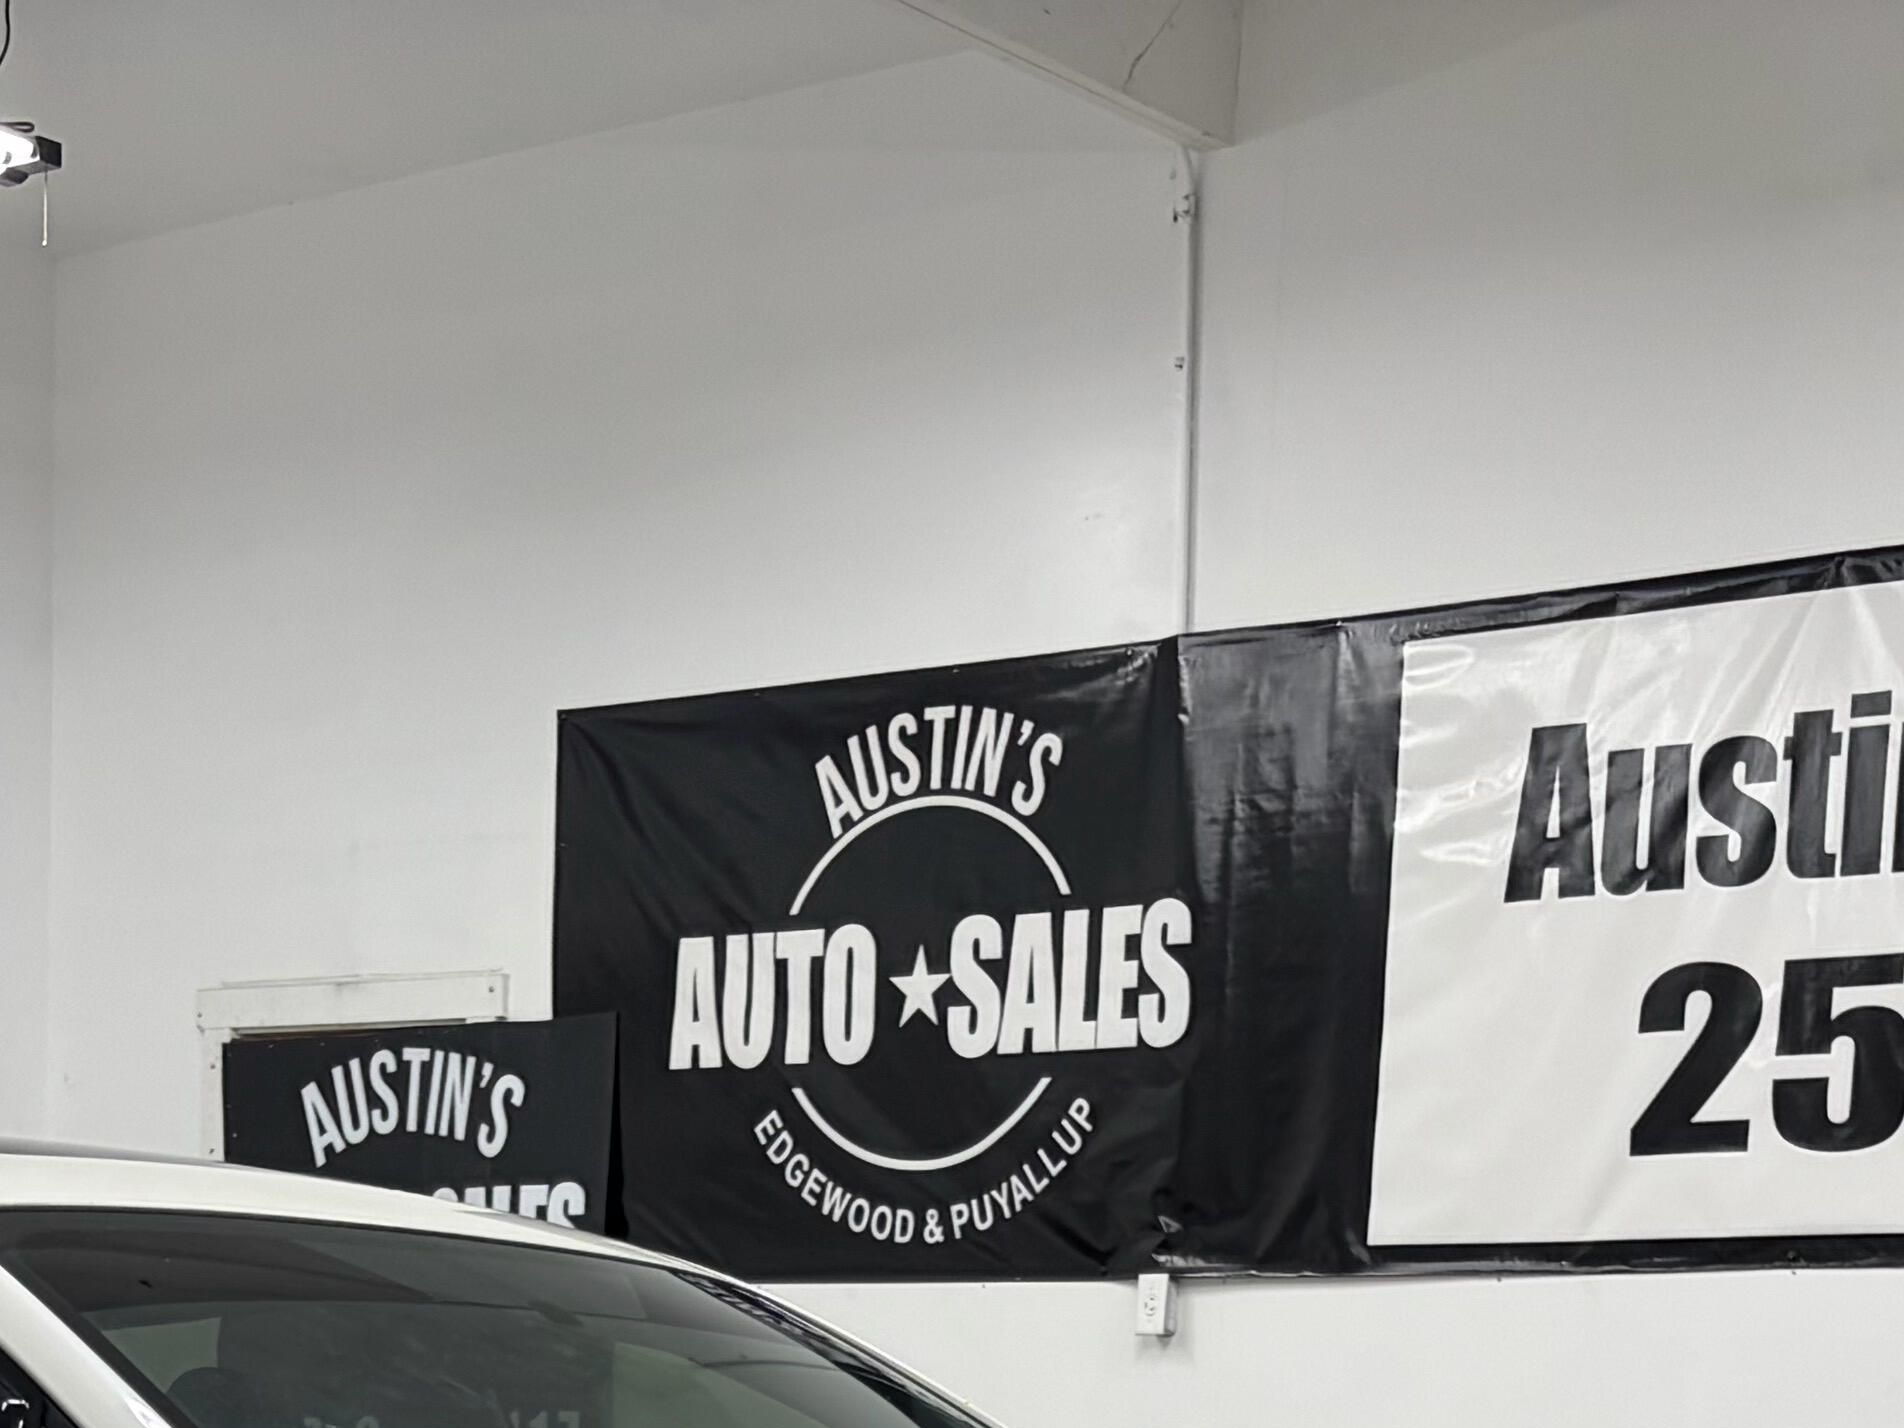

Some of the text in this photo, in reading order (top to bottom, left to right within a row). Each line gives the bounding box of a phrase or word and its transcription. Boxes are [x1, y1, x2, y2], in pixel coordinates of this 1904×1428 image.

[815, 704, 1063, 839] AUSTIN'S
[668, 897, 1192, 1070] AUTO SALES
[300, 1047, 525, 1168] AUSTIN'S
[753, 1097, 1093, 1244] EDGEWOOD & PUYALLUP
